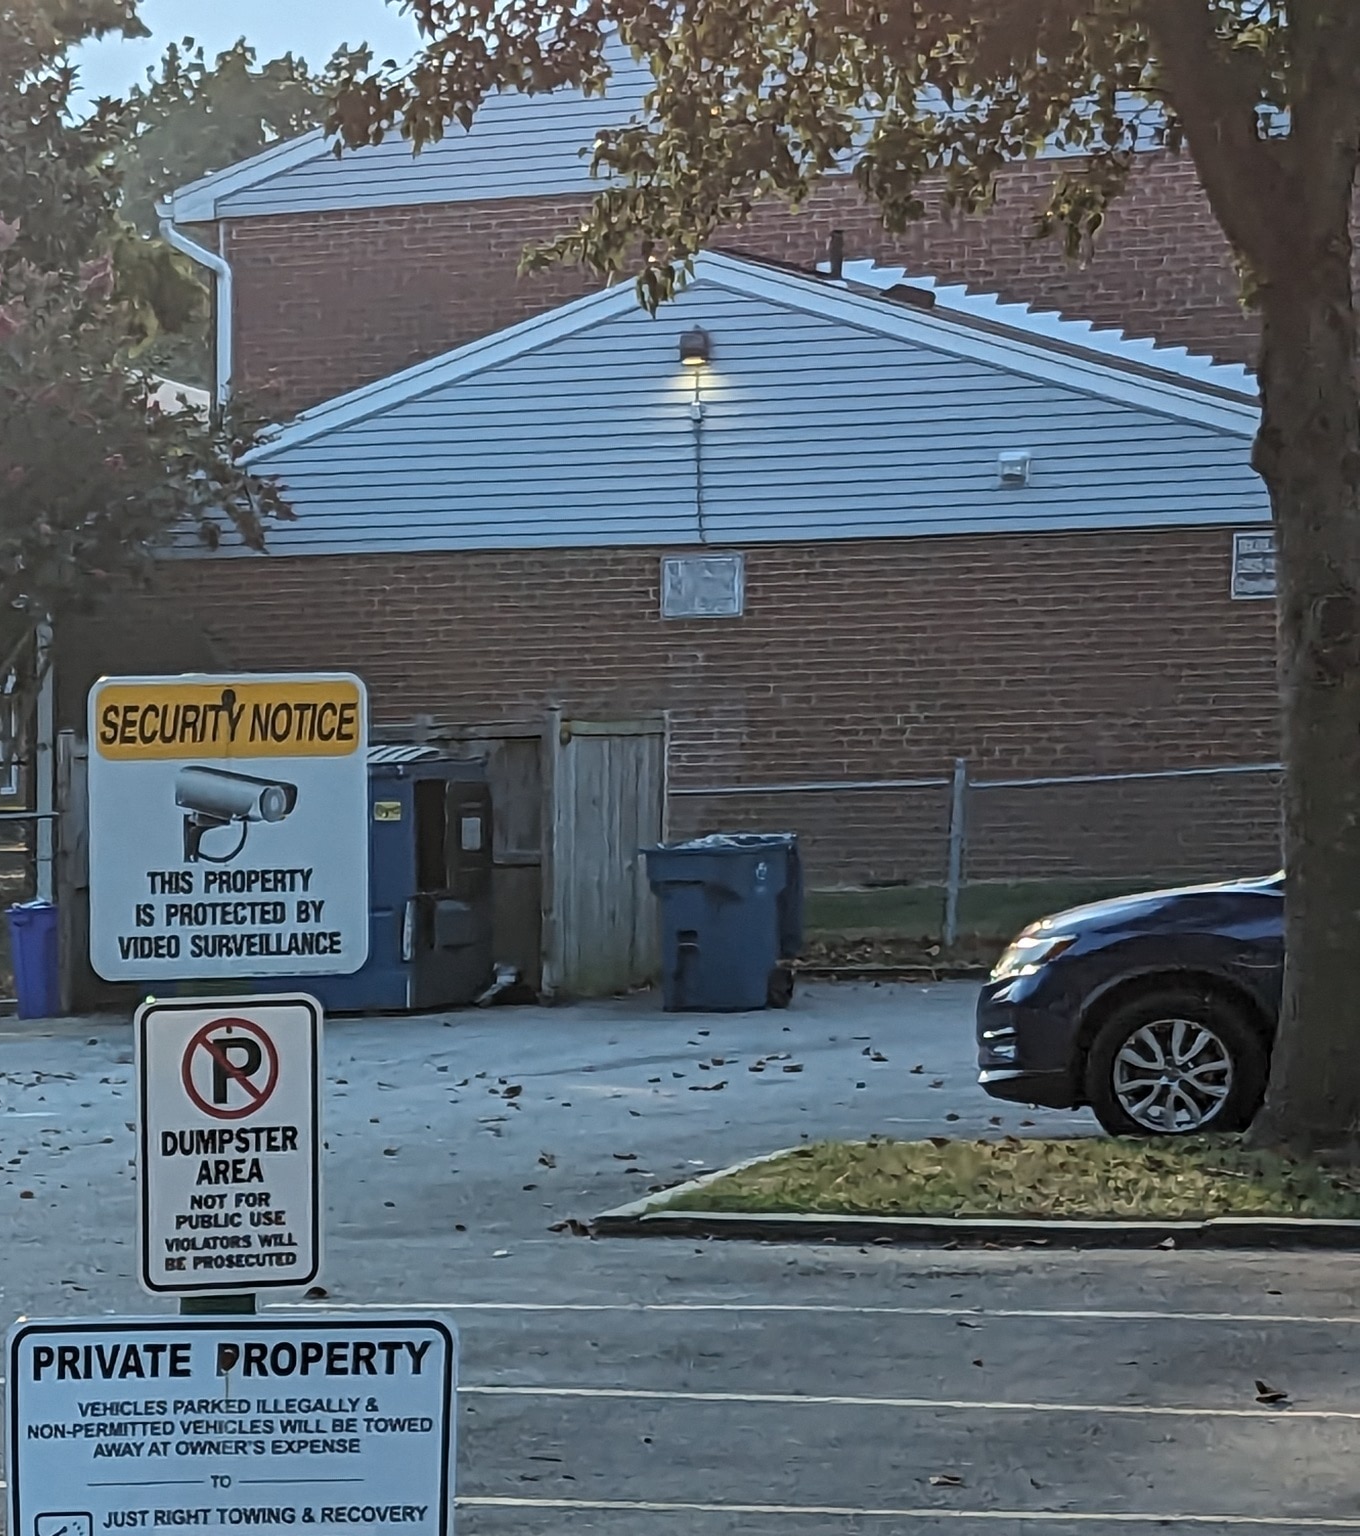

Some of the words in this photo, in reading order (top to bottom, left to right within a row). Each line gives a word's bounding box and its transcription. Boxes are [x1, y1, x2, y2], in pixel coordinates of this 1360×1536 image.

[100, 703, 245, 745] SECURITY
[249, 702, 357, 743] NOTICE
[147, 870, 193, 895] THIS
[204, 868, 313, 894] PROPERTY
[136, 903, 155, 927] IS
[166, 901, 286, 926] PROTECTED
[296, 900, 325, 923] BY
[118, 935, 180, 960] VIDEO
[190, 931, 342, 958] SURVEILLANCE
[161, 1126, 298, 1157] DUMPSTER
[196, 1158, 264, 1186] AREA
[191, 1194, 228, 1210] NOT
[235, 1192, 270, 1208] FOR
[175, 1212, 242, 1230] PUBLIC
[249, 1210, 286, 1226] USE
[164, 1234, 252, 1252] VIOLATORS
[258, 1232, 298, 1248] WILL
[165, 1256, 186, 1271] BE
[193, 1252, 297, 1270] PROSECUTED
[32, 1342, 192, 1381] PRIVATE
[216, 1340, 431, 1378] PROPERTY
[78, 1400, 167, 1417] VEHICLES
[173, 1399, 251, 1415] PARKED
[257, 1398, 360, 1414] ILLEGALLY
[365, 1397, 379, 1412] &
[27, 1421, 175, 1439] NON-PERMITTED
[180, 1419, 274, 1435] VEHICLES
[280, 1419, 328, 1434] WILL
[332, 1418, 358, 1433] BE
[363, 1417, 433, 1433] TOWED
[93, 1442, 145, 1458] AWAY
[147, 1441, 172, 1457] AT
[175, 1440, 265, 1456] OWNER'S
[271, 1438, 361, 1455] EXPENSE
[211, 1475, 231, 1489] TO
[103, 1510, 149, 1528] JUST
[154, 1508, 211, 1526] RIGHT
[216, 1507, 296, 1524] TOWING
[302, 1507, 315, 1523] &
[320, 1505, 428, 1523] RECOVERY
